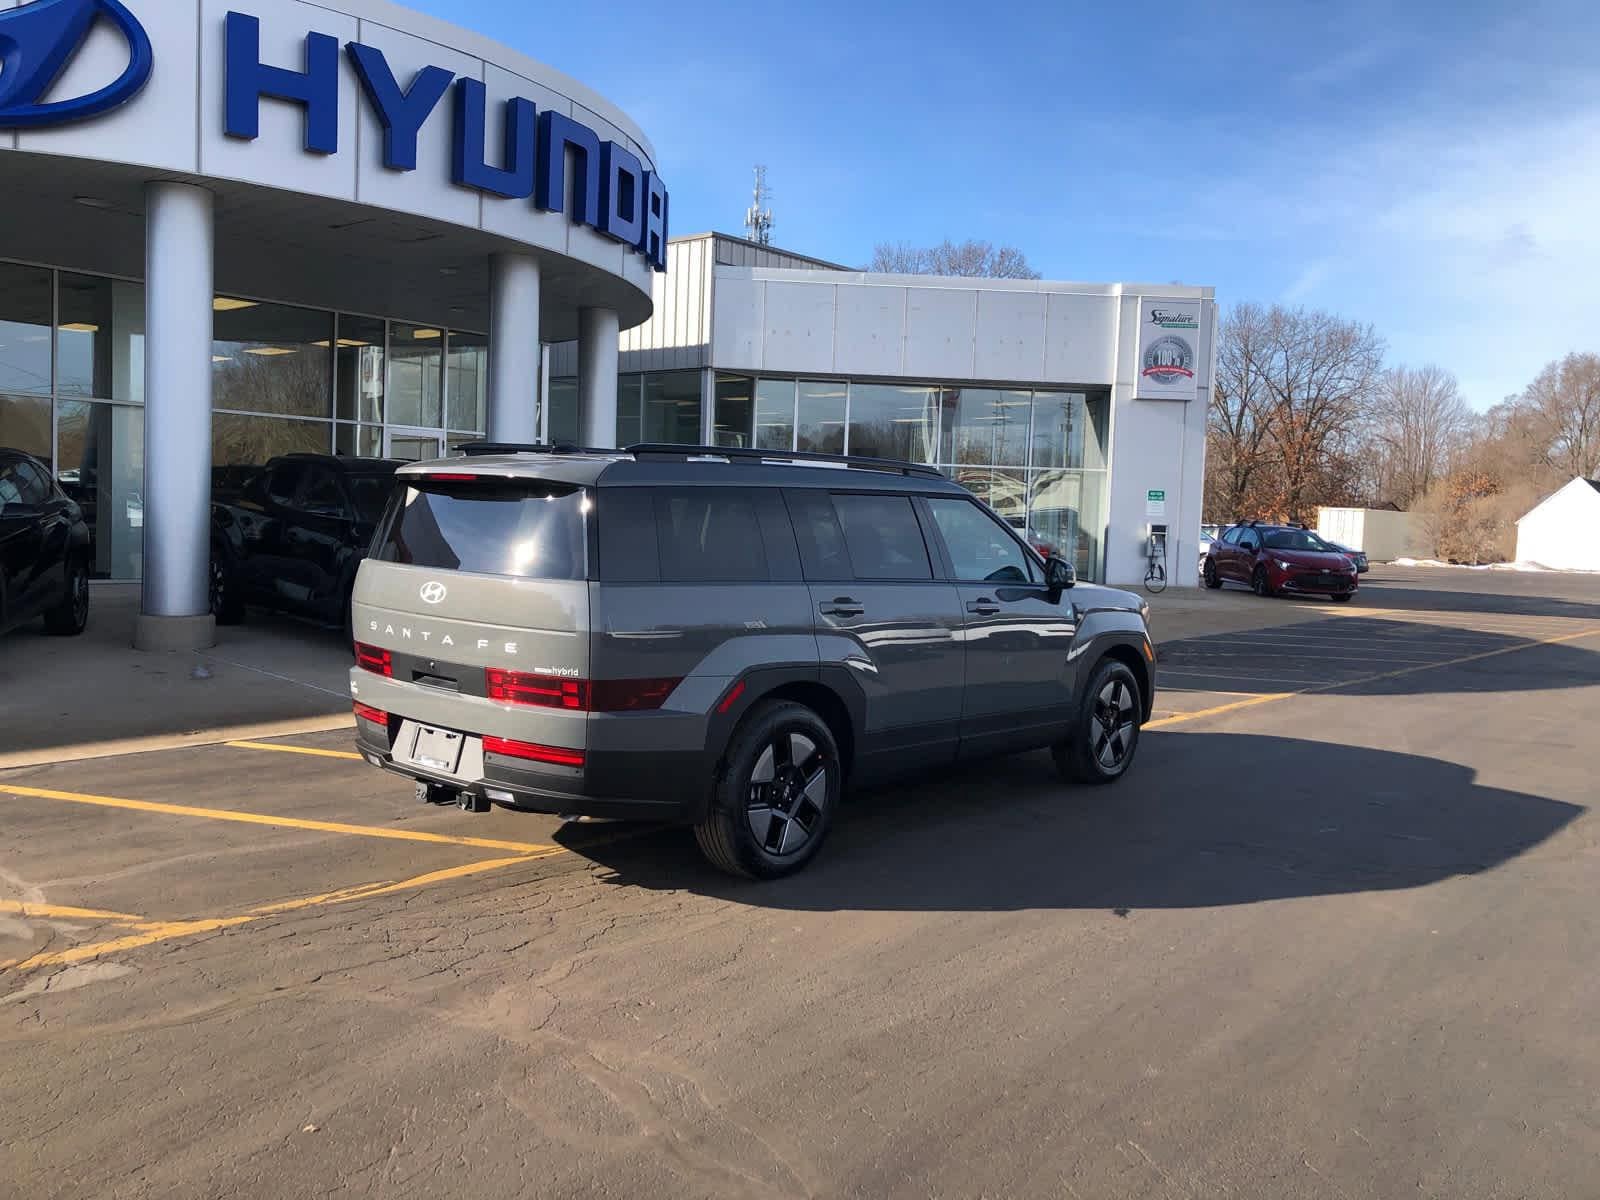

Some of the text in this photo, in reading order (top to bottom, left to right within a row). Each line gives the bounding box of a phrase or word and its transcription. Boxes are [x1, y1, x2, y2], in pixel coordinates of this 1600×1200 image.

[224, 11, 668, 272] HYUNDA
[1151, 309, 1193, 325] Signature
[370, 621, 518, 654] SANTA FE
[551, 666, 579, 677] hybrid
